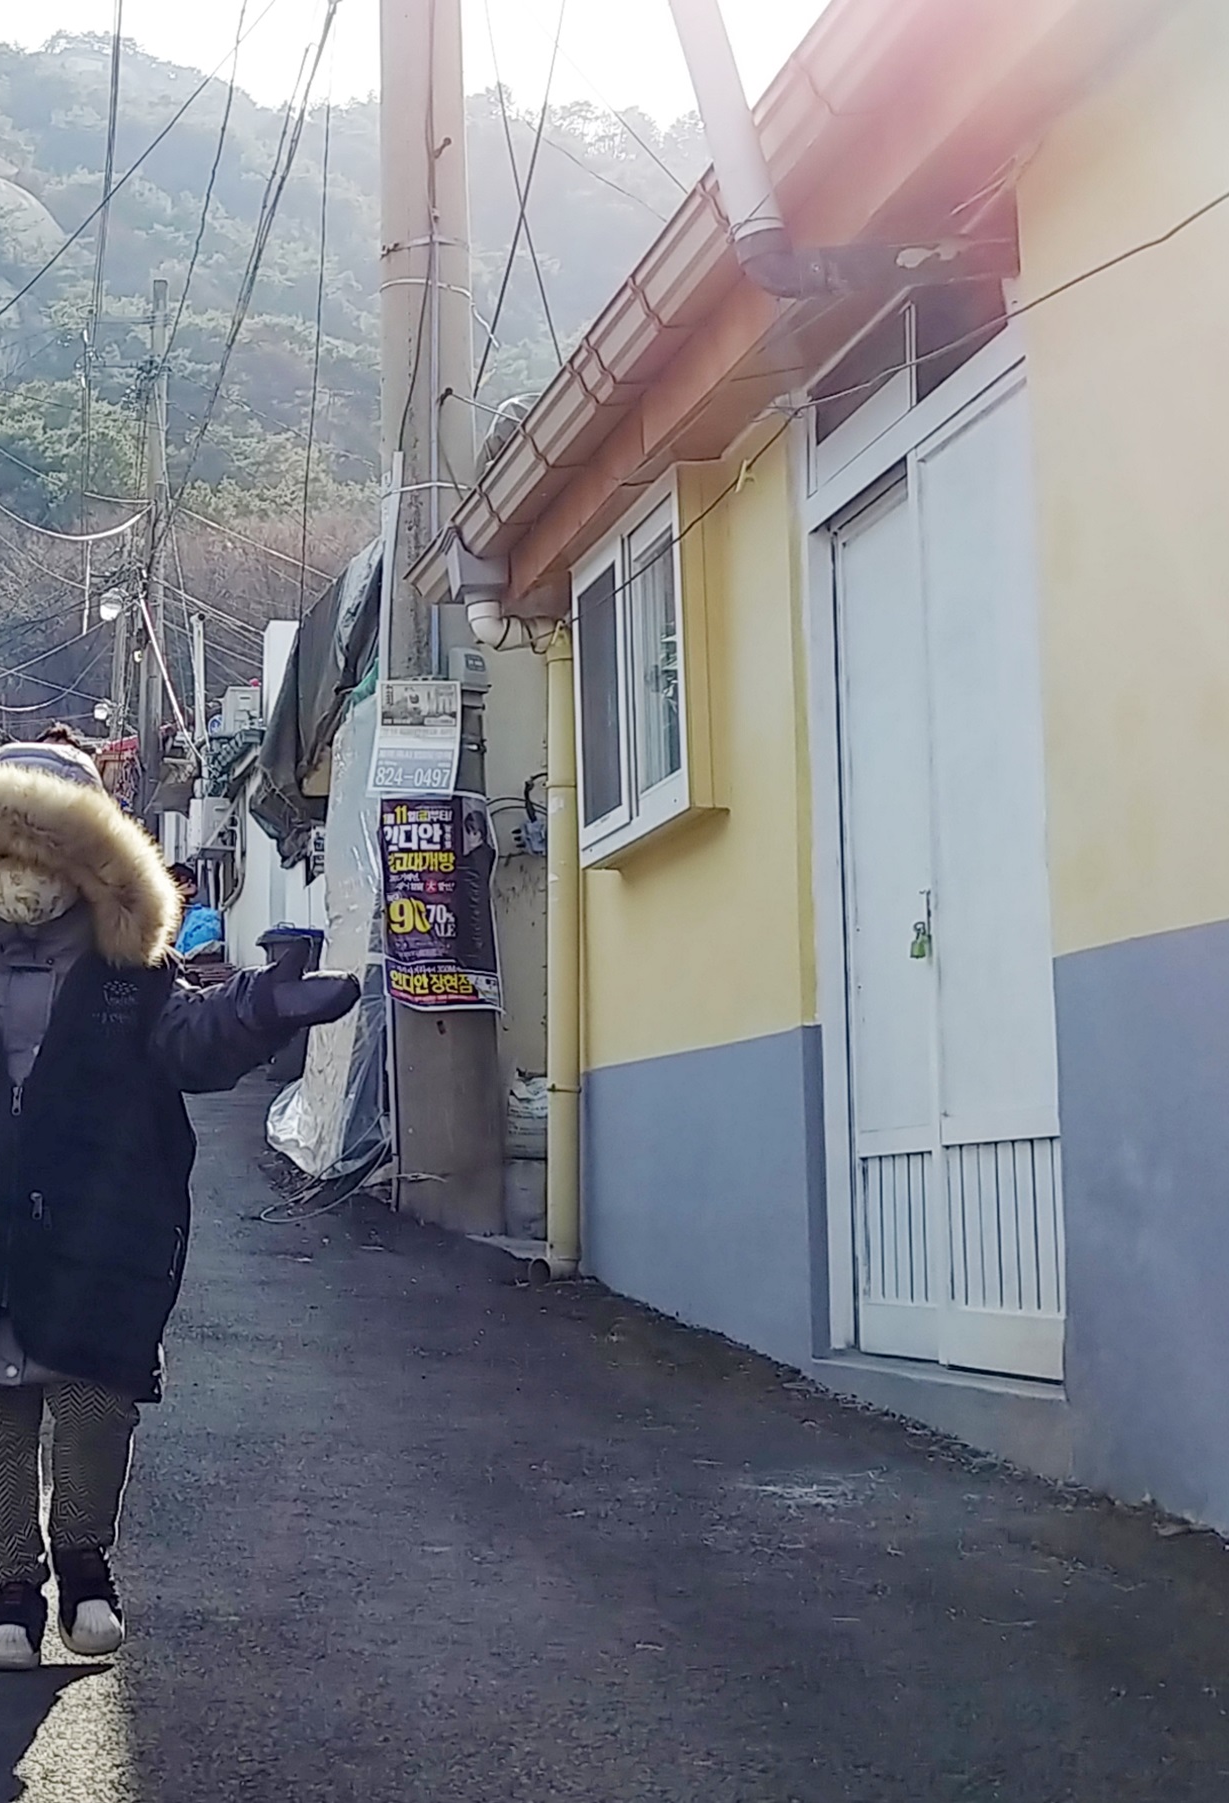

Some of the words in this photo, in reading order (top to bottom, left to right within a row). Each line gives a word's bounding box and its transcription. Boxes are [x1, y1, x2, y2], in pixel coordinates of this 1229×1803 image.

[375, 767, 451, 787] 824-0497
[390, 970, 429, 994] 인디안
[429, 973, 473, 994] 장현점
